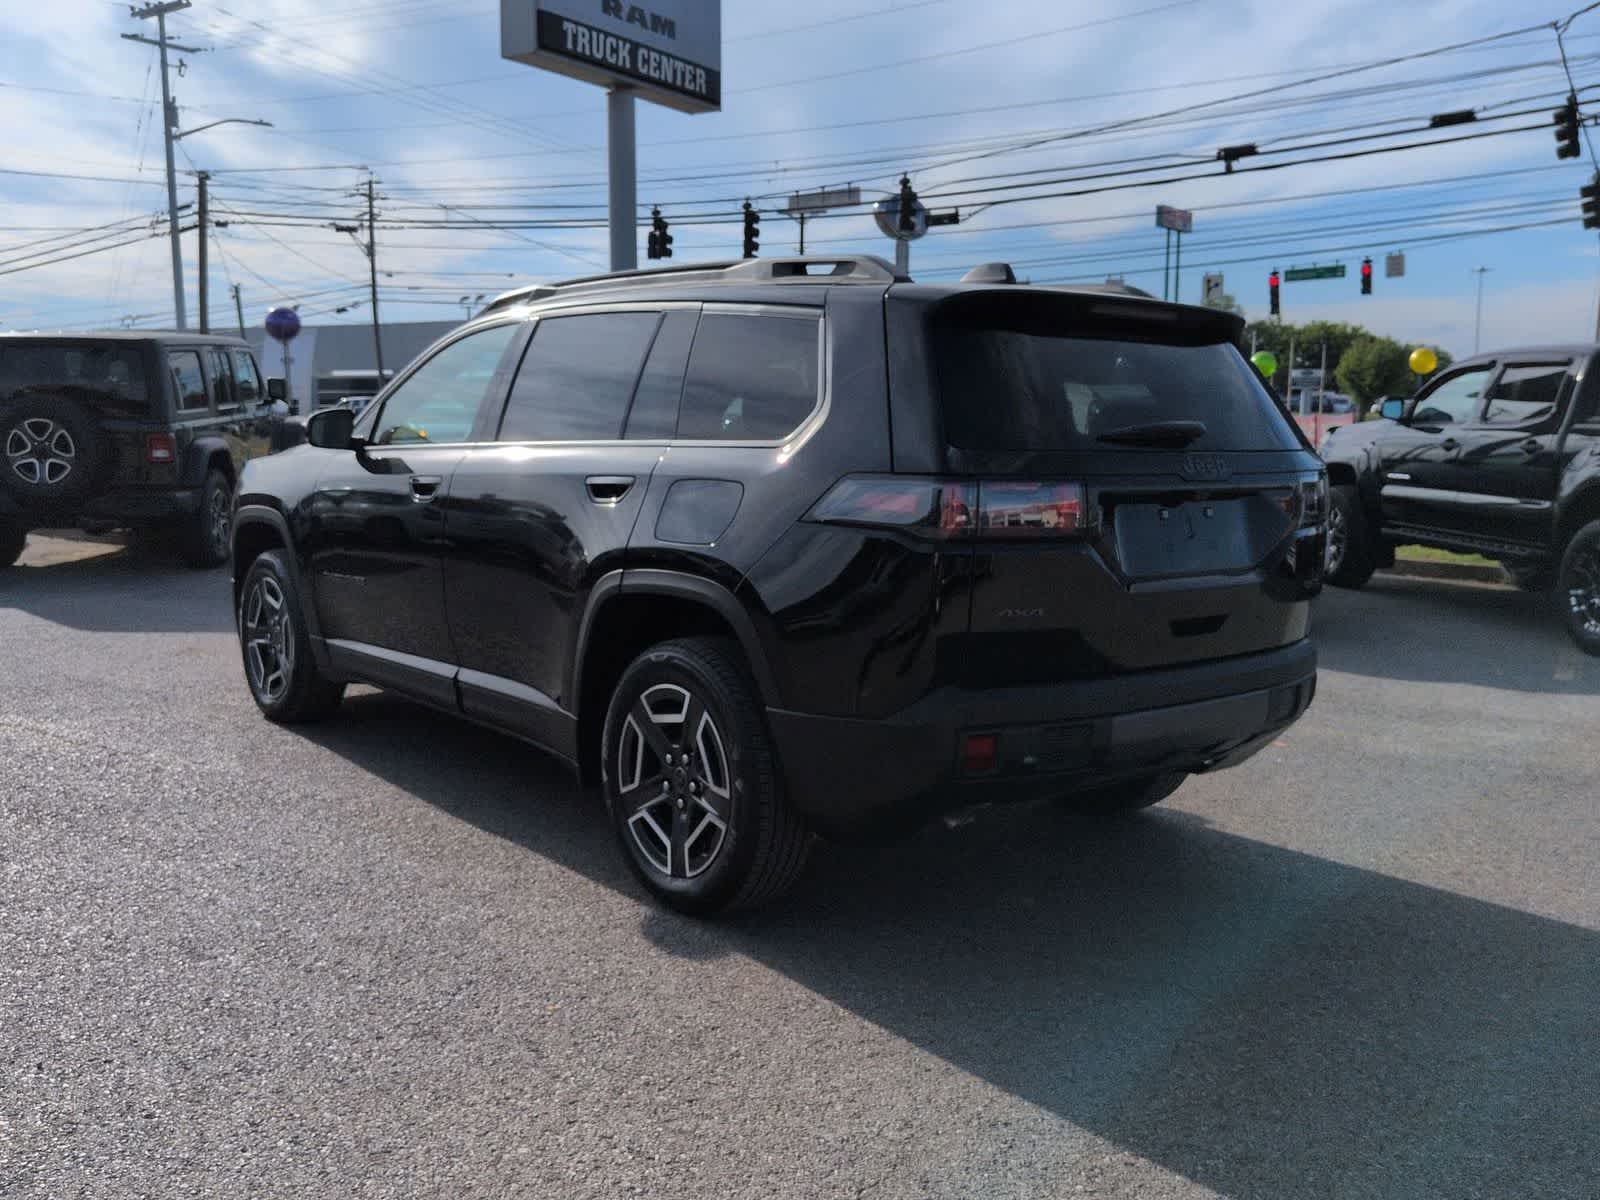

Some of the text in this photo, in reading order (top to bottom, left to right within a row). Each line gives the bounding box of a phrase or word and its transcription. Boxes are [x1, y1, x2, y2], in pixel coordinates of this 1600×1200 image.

[601, 0, 676, 40] RAM
[562, 20, 707, 95] TRUCK CENTER
